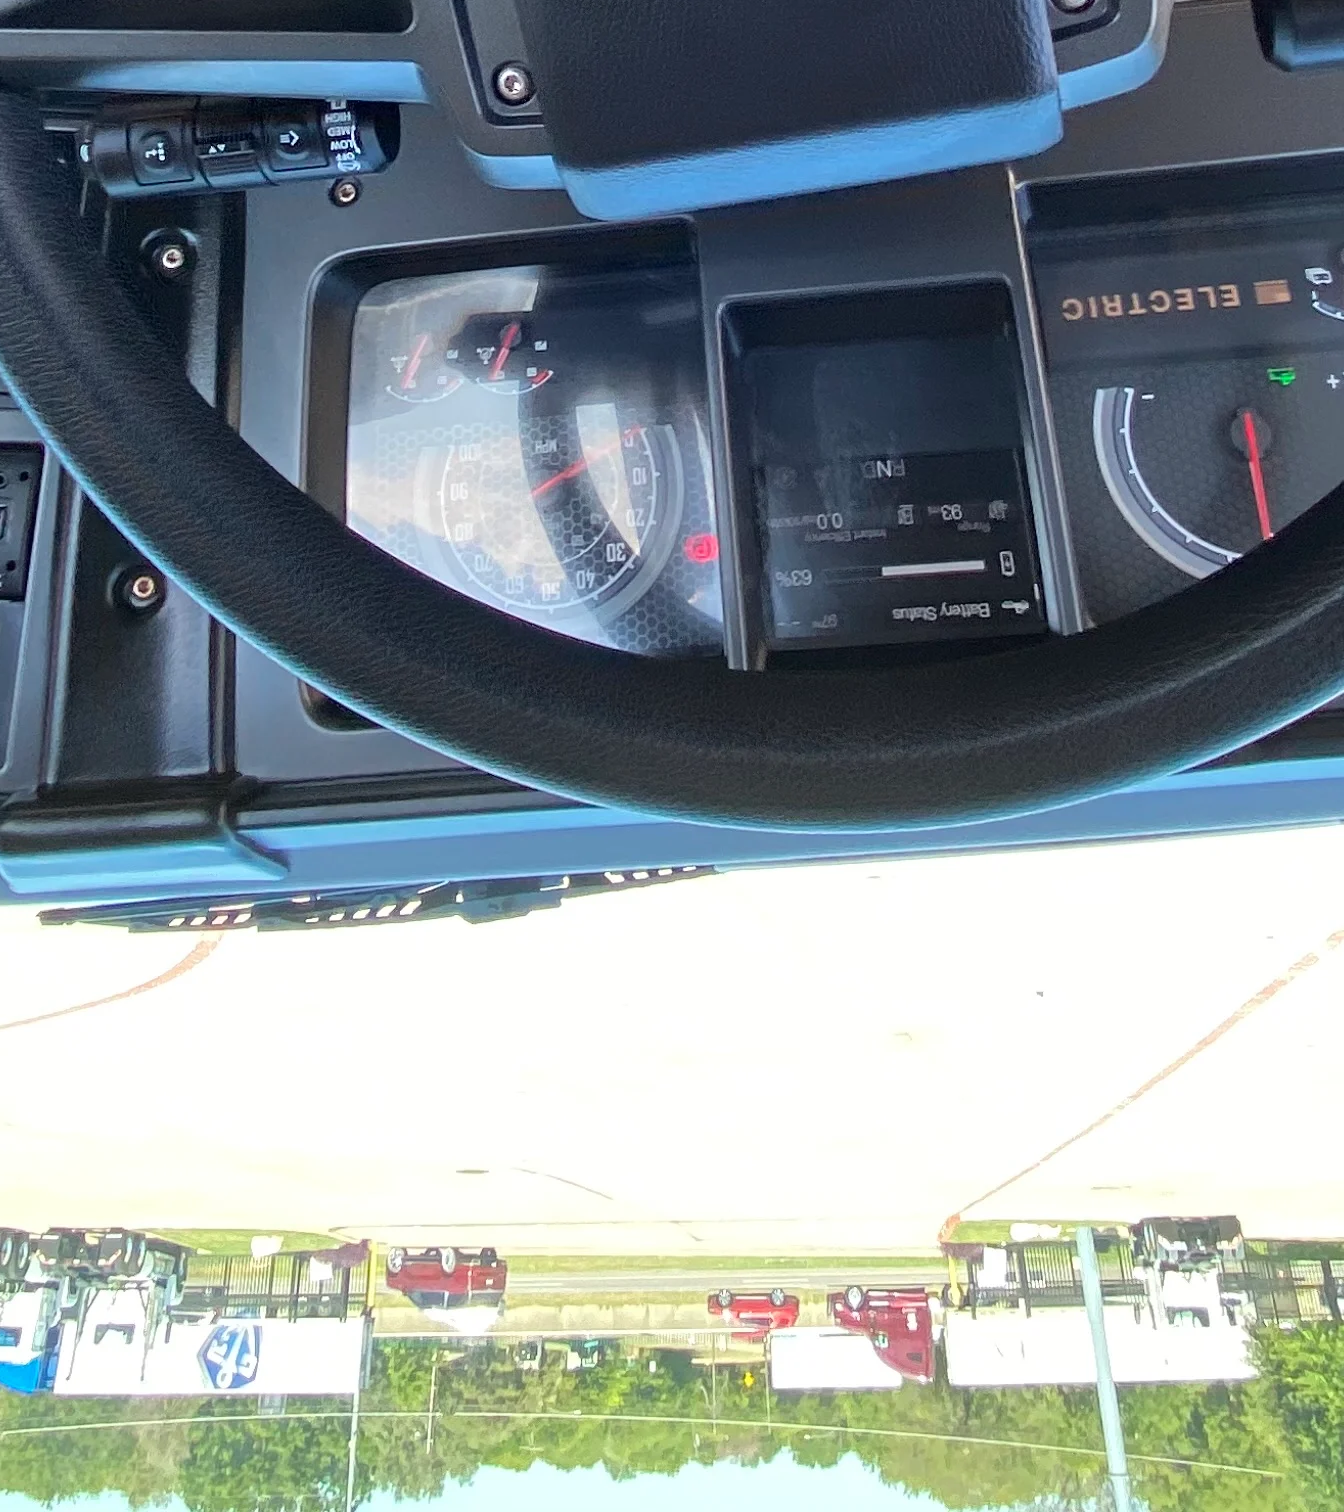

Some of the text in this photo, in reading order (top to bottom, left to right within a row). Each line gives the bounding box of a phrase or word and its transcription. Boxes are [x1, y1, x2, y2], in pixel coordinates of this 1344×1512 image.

[324, 111, 352, 123] HIGH
[327, 126, 352, 137] MED
[330, 139, 353, 150] LOW
[335, 152, 355, 162] OFF
[1061, 282, 1240, 321] ELECTRIC
[534, 439, 557, 454] MPH
[632, 467, 647, 485] 10
[449, 482, 469, 501] 90
[626, 508, 645, 527] 20
[606, 542, 625, 562] 30
[474, 554, 491, 572] 70
[506, 576, 524, 594] 60
[576, 570, 595, 588] 40
[775, 569, 813, 587] 63%
[542, 583, 560, 601] 50
[892, 605, 938, 621] Status
[940, 601, 991, 618] Battery
